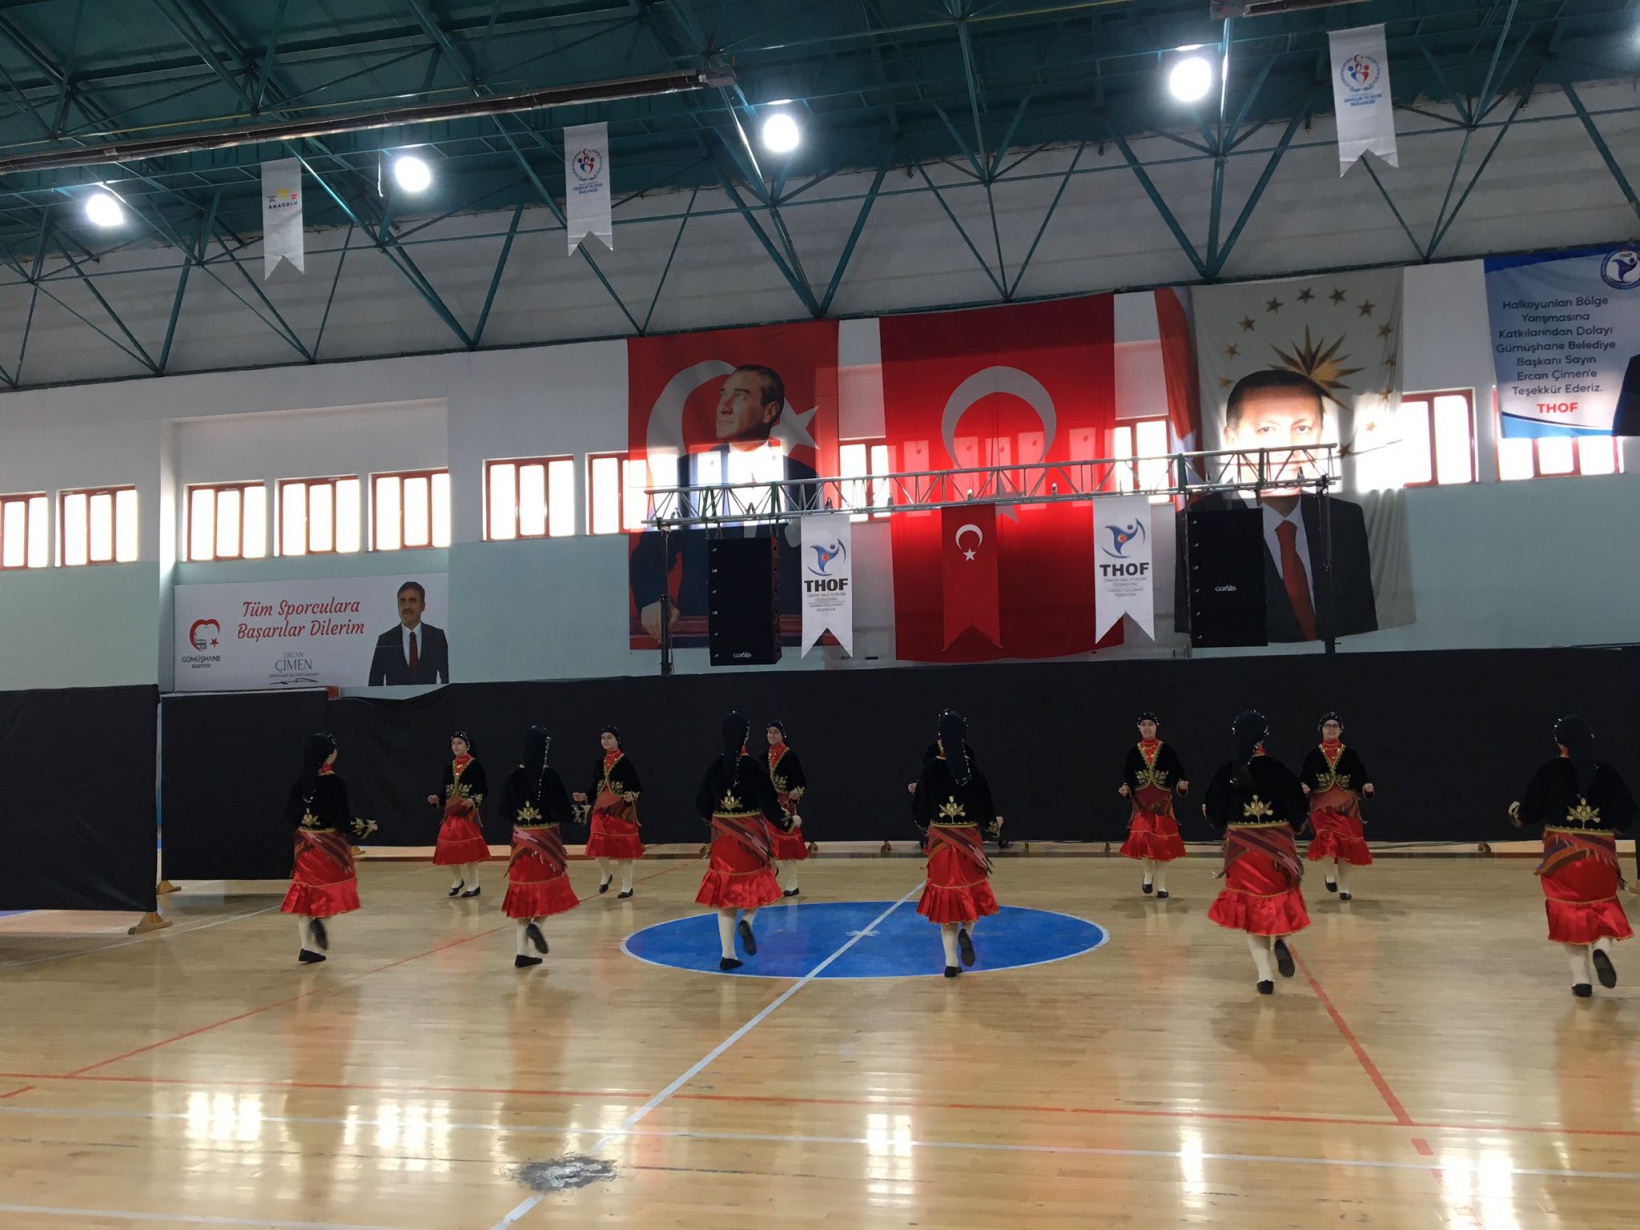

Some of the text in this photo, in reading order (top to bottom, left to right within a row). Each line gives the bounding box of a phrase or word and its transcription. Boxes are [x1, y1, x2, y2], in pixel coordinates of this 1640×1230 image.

[268, 201, 298, 209] ANADOLU
[1502, 296, 1609, 311] Halkoyunları Bölge
[1521, 313, 1590, 324] Yarışmasına
[1499, 325, 1613, 339] Katkılarından Dolayı
[1496, 340, 1616, 353] Gümüşhane Belediye
[1516, 354, 1597, 367] Başkanı Sayın
[1517, 371, 1549, 381] Ercan
[1512, 382, 1603, 397] Teşekkür Ederiz.
[1536, 402, 1579, 413] THOF
[1099, 562, 1150, 577] THOF
[803, 578, 849, 592] THOF
[242, 596, 361, 620] Tüm Sporculara
[237, 618, 365, 642] Başarılar Dilerim
[181, 655, 221, 664] GÜMÜŞHANE
[283, 651, 305, 659] ERCAN
[274, 658, 313, 673] ÇİMEN
